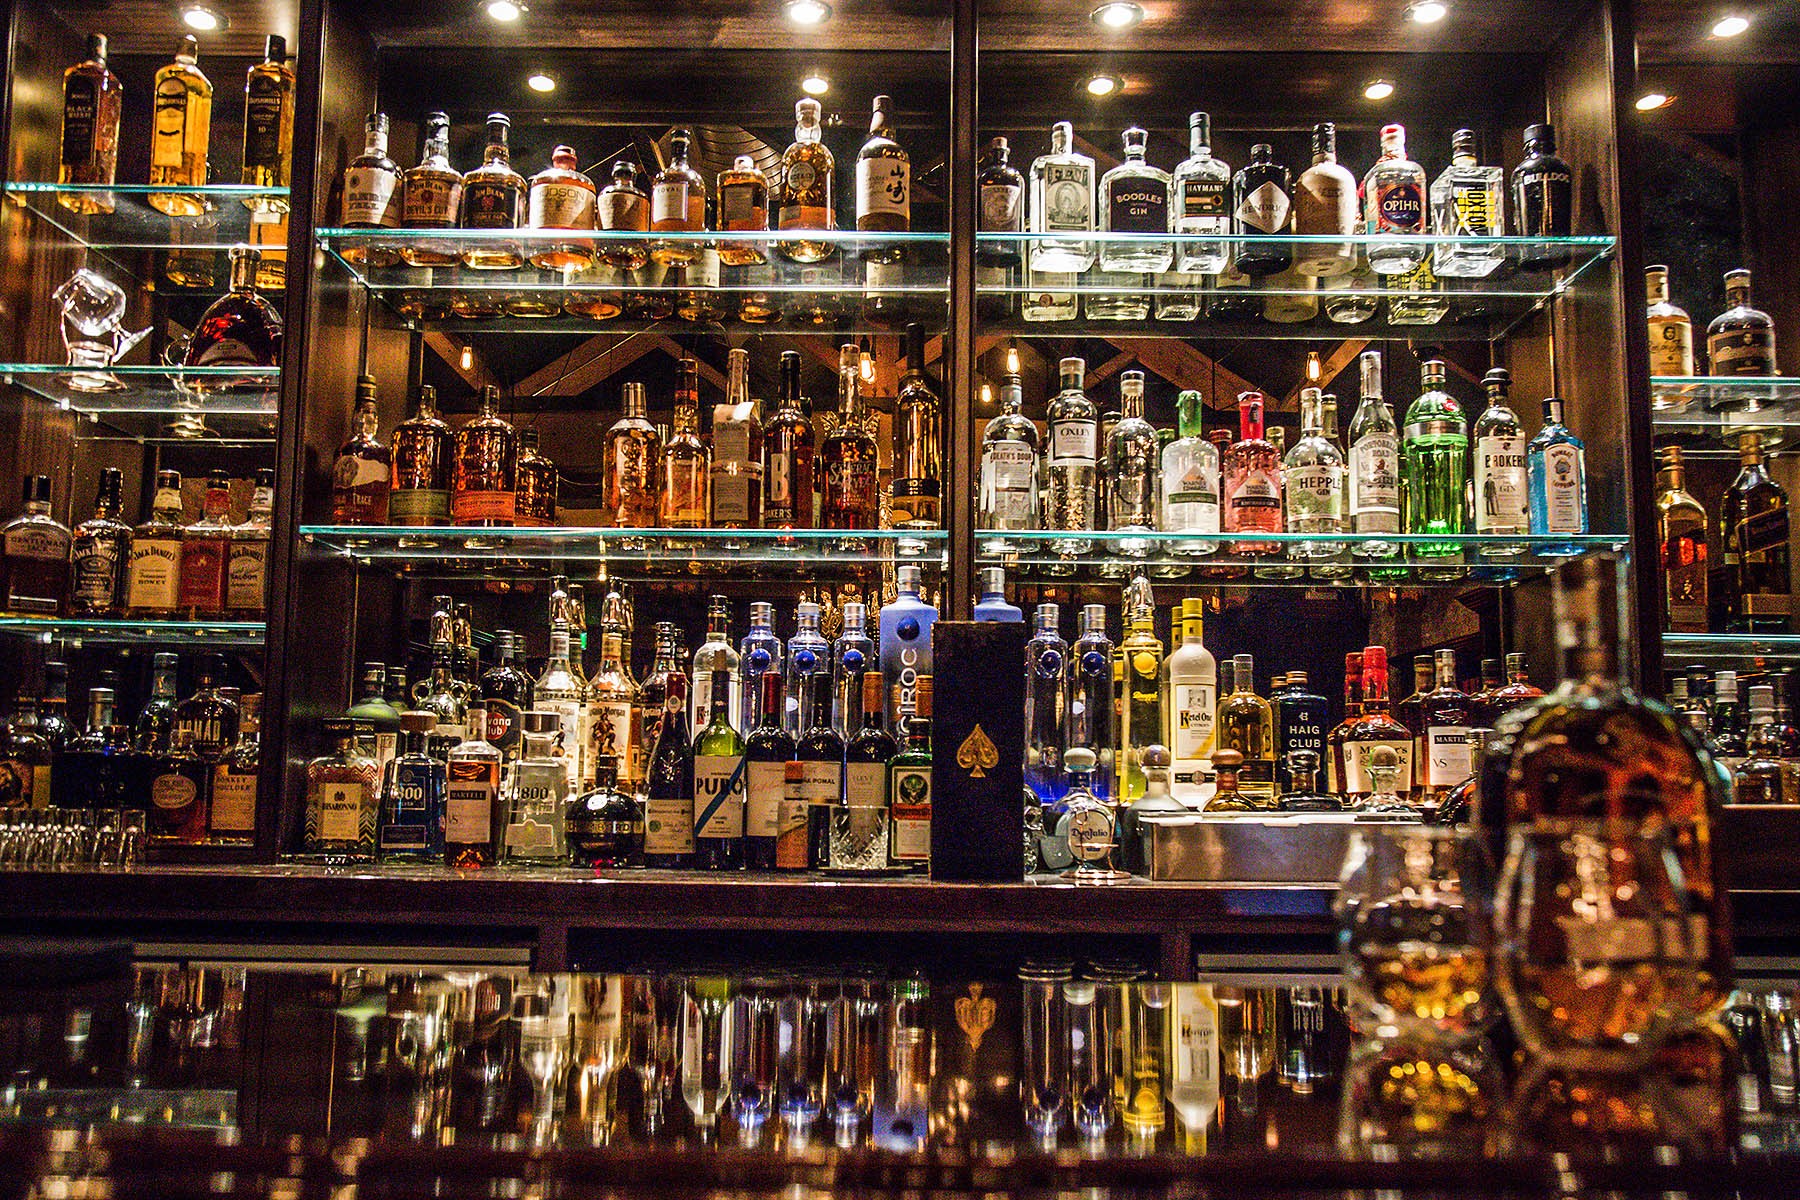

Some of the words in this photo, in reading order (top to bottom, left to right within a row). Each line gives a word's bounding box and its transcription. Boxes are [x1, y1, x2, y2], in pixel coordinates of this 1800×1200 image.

[1115, 192, 1163, 205] BOODLES
[1129, 207, 1148, 215] GIN
[1383, 200, 1420, 213] OPIHR
[1300, 476, 1341, 490] HEPPLE
[487, 717, 512, 726] vana
[1180, 711, 1201, 727] Ketel
[487, 725, 503, 735] lub
[1289, 725, 1320, 735] HAIG
[1289, 738, 1321, 748] CLUB
[1435, 735, 1466, 743] MARTEL
[696, 777, 743, 795] PURO
